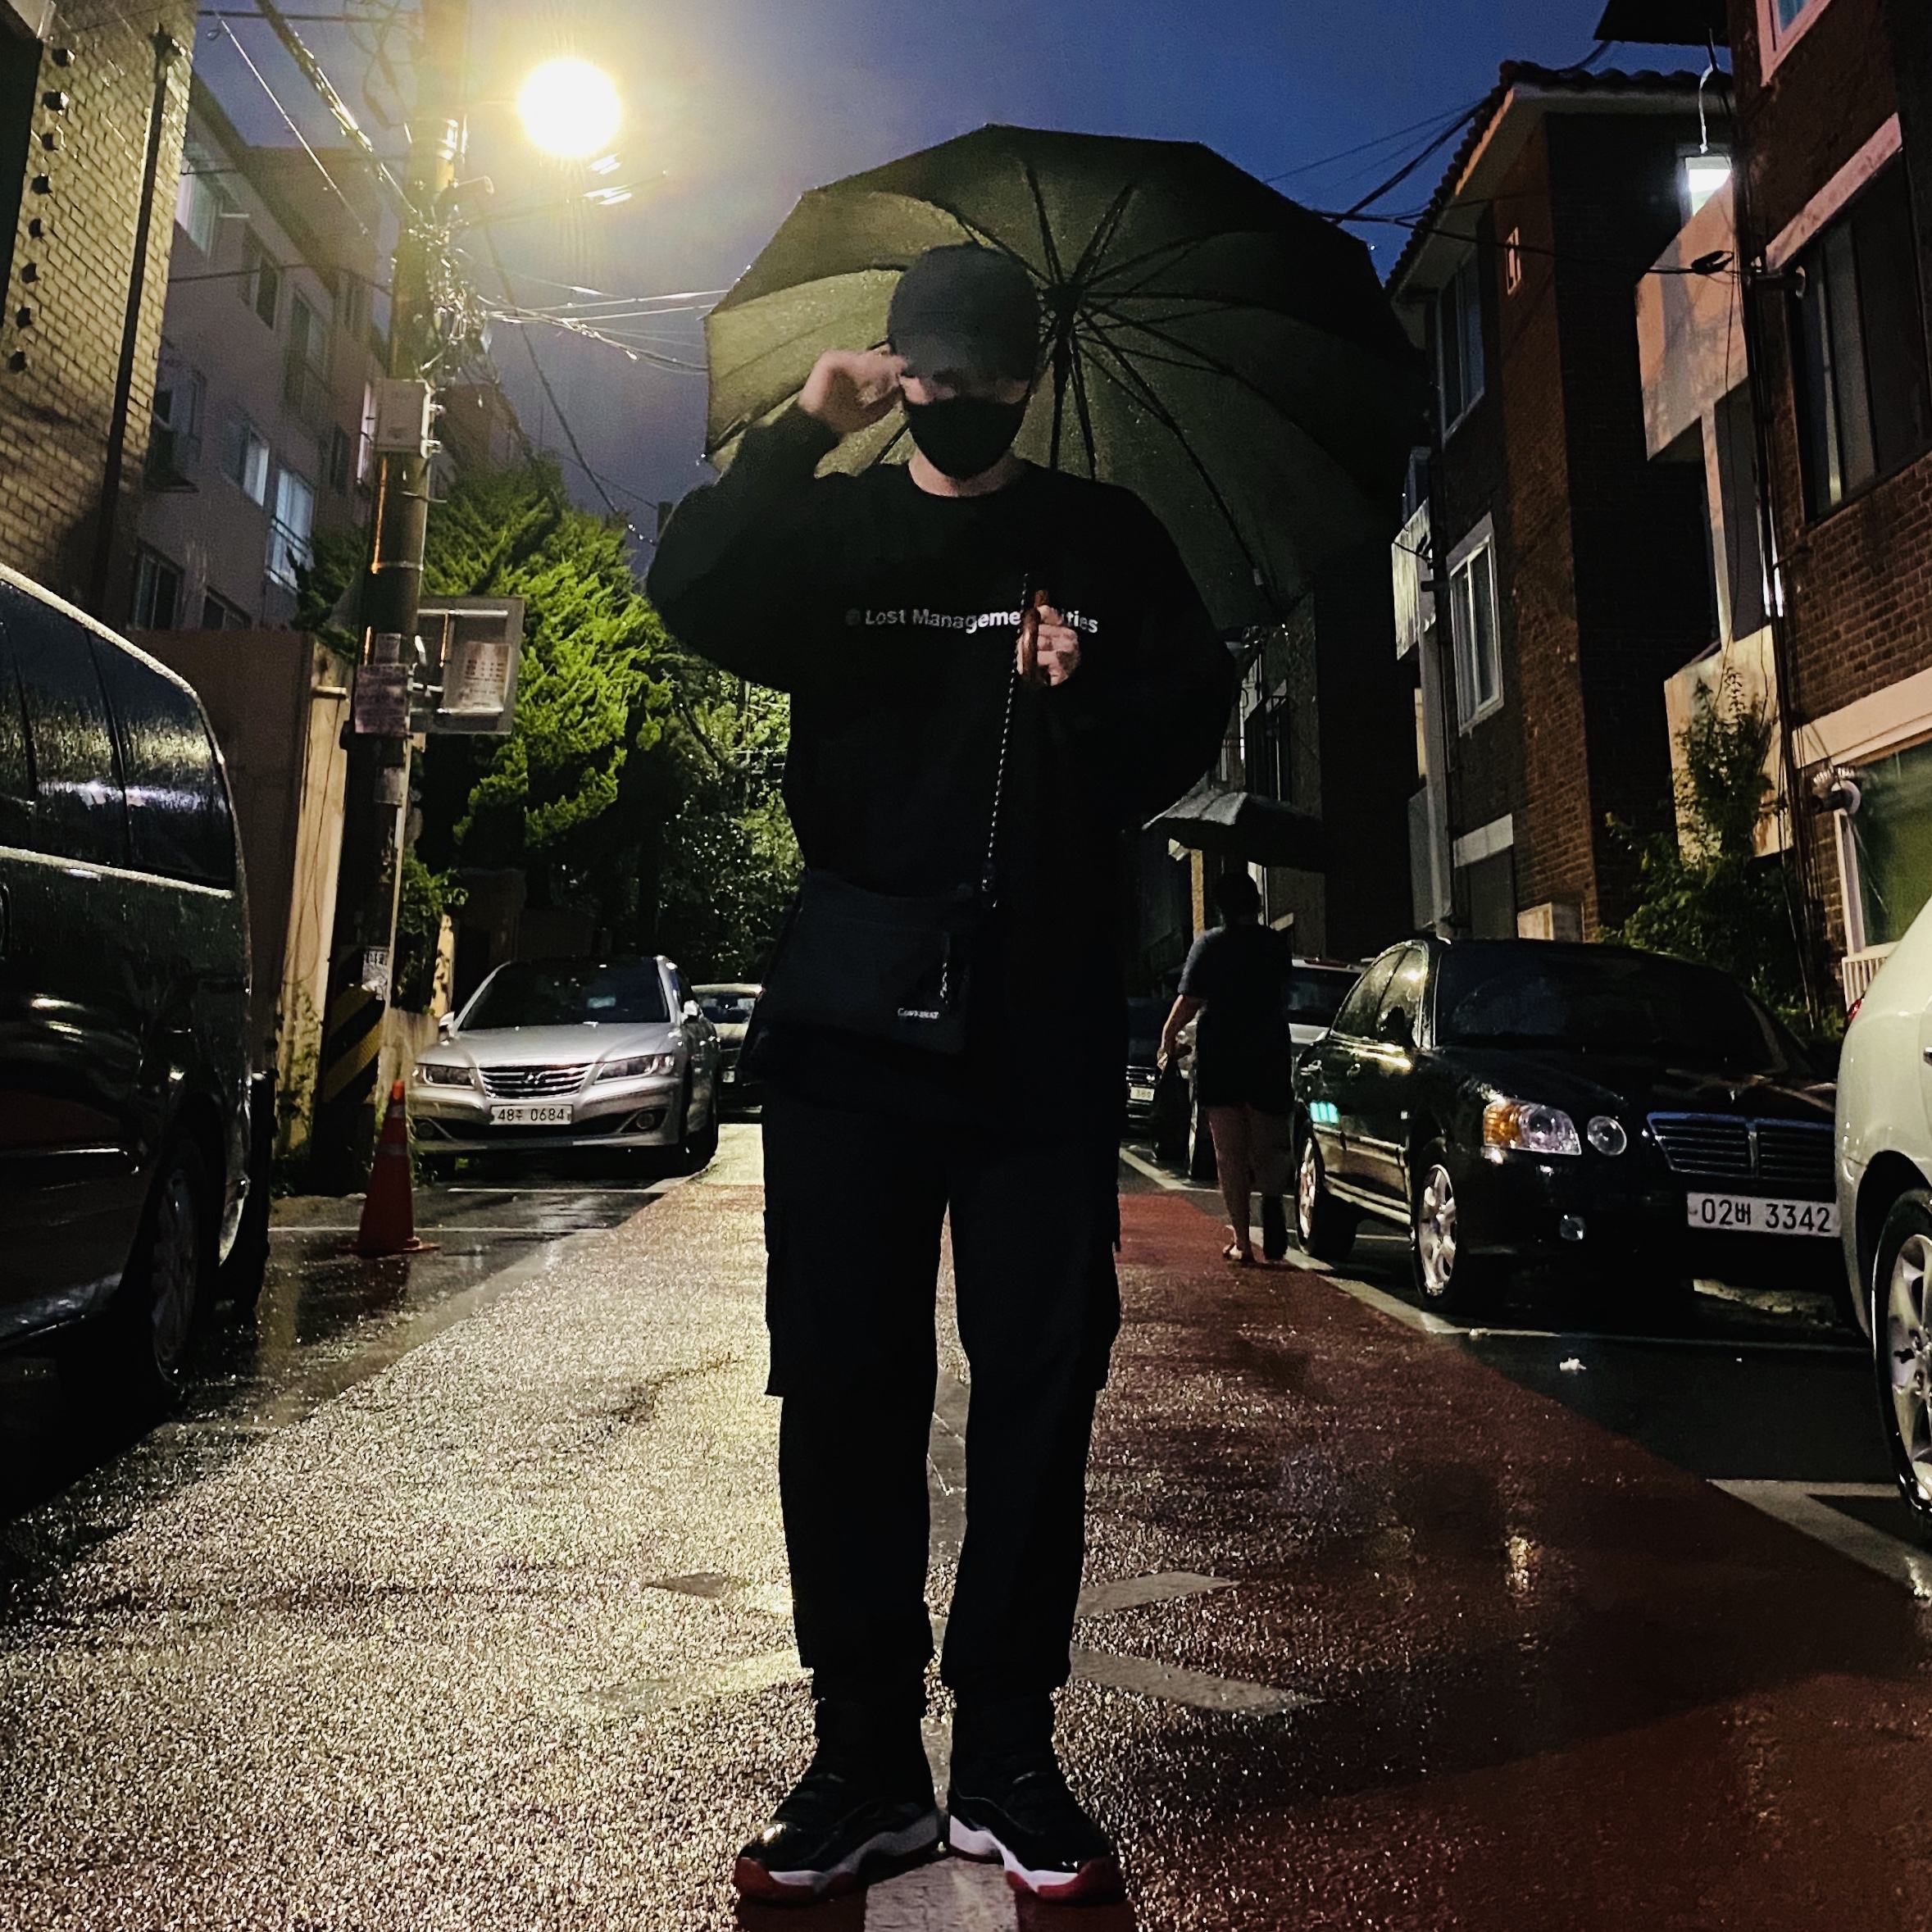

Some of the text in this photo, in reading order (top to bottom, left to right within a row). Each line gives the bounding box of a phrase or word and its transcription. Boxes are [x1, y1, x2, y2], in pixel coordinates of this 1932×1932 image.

[865, 609, 906, 625] Lost
[912, 608, 1021, 634] Manageme
[530, 1107, 564, 1121] 0684
[1766, 1203, 1831, 1233] 3342
